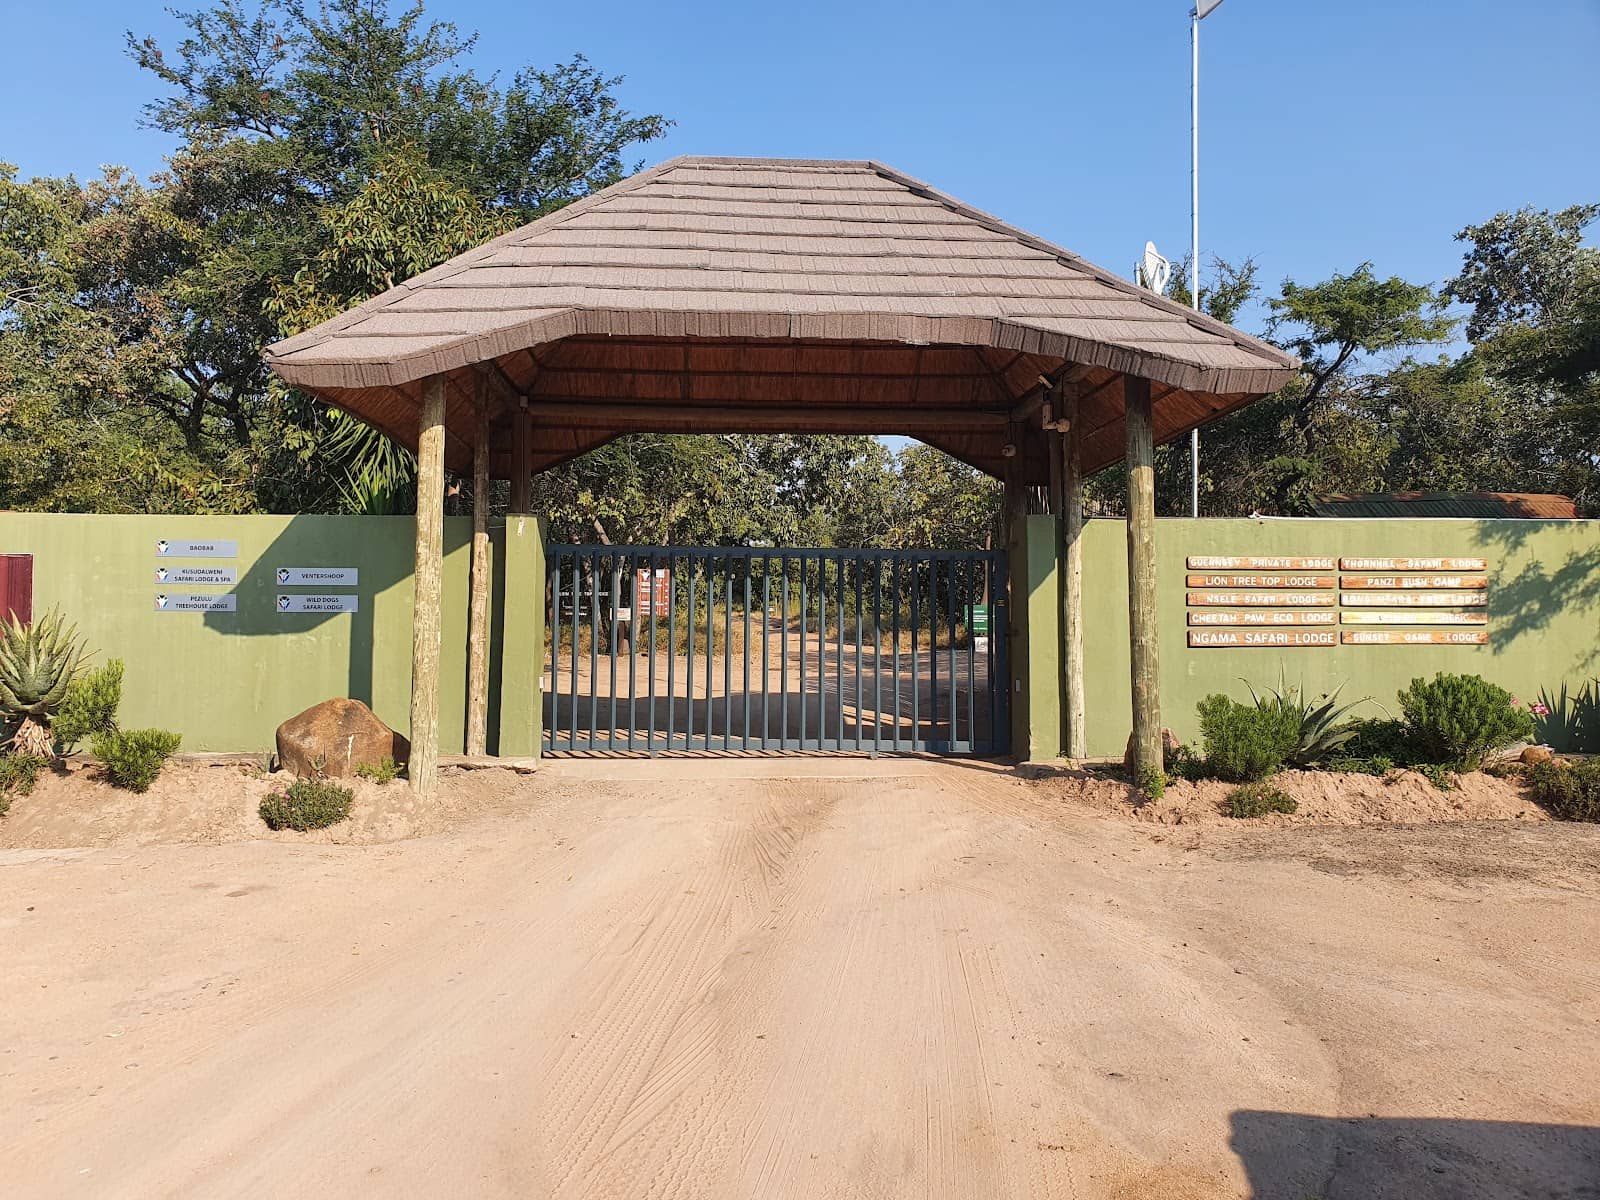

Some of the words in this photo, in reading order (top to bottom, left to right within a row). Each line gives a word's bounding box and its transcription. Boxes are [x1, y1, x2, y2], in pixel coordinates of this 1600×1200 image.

[1190, 558, 1241, 568] GUERNSEY
[1251, 558, 1291, 568] PRIVATE
[1302, 558, 1334, 568] LODGE
[1345, 559, 1395, 568] THORNHILL
[1407, 559, 1442, 568] SAFARI
[1452, 559, 1484, 568] LODGE
[1205, 576, 1228, 586] LION
[1232, 576, 1256, 586] TREE
[1261, 576, 1281, 586] TOP
[1284, 576, 1318, 586] LODGE
[1367, 578, 1396, 586] PANZI
[1402, 578, 1428, 586] BUSH
[1433, 578, 1462, 586] CAMP
[1206, 594, 1238, 604] NSELE
[1245, 594, 1277, 604] SAFARI
[1286, 594, 1318, 604] LODGE
[1191, 614, 1238, 623] CHEETAH
[1244, 614, 1266, 623] PAW
[1273, 614, 1294, 623] ECO
[1301, 614, 1334, 623] LODGE
[1192, 633, 1239, 644] NGAMA
[1245, 633, 1288, 644] SAFARI
[1295, 633, 1335, 644] LODGE
[1353, 632, 1390, 642] SUNSET
[1404, 632, 1432, 642] GAME
[1446, 632, 1478, 642] LODGE
